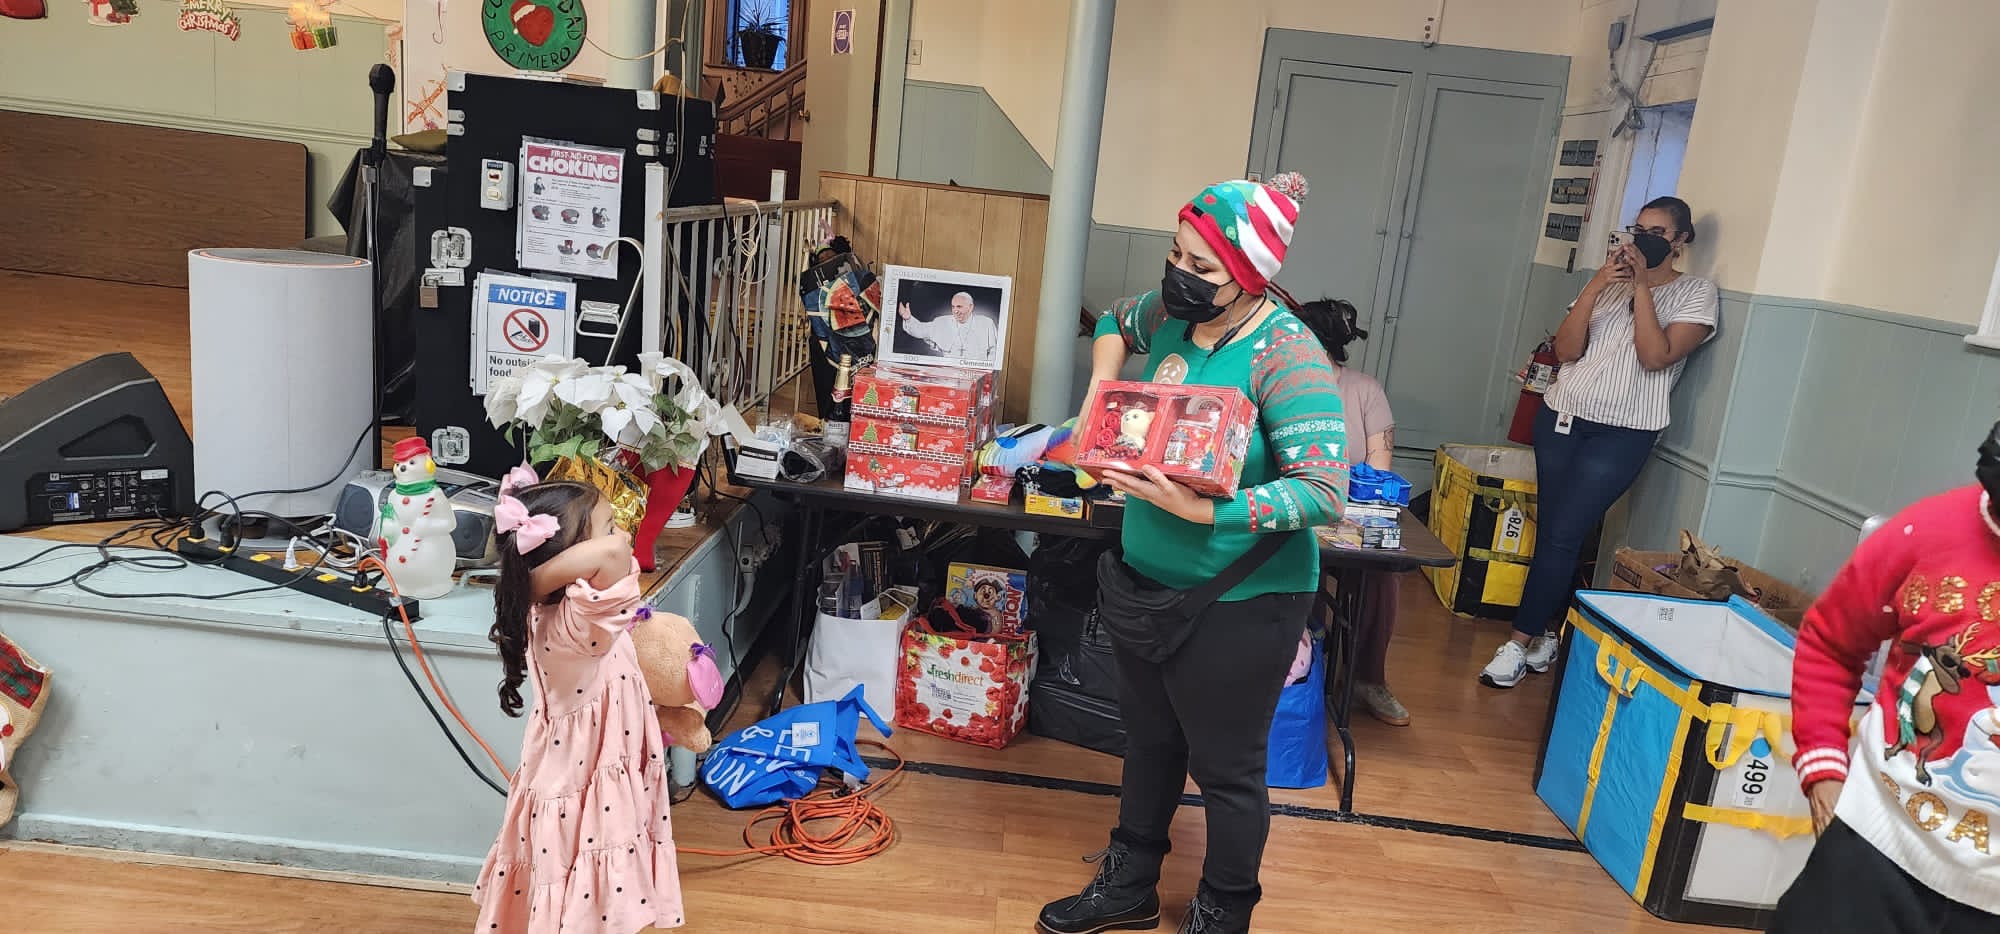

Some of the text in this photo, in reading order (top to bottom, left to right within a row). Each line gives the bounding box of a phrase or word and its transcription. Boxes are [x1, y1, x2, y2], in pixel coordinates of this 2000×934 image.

[490, 30, 571, 68] PRIMERO
[528, 155, 618, 181] CHOKING
[498, 288, 557, 306] NOTICE
[489, 356, 536, 368] No outsi
[489, 367, 512, 377] food
[1506, 516, 1522, 539] 978
[927, 663, 984, 687] freshdirect
[1742, 759, 1769, 794] 499
